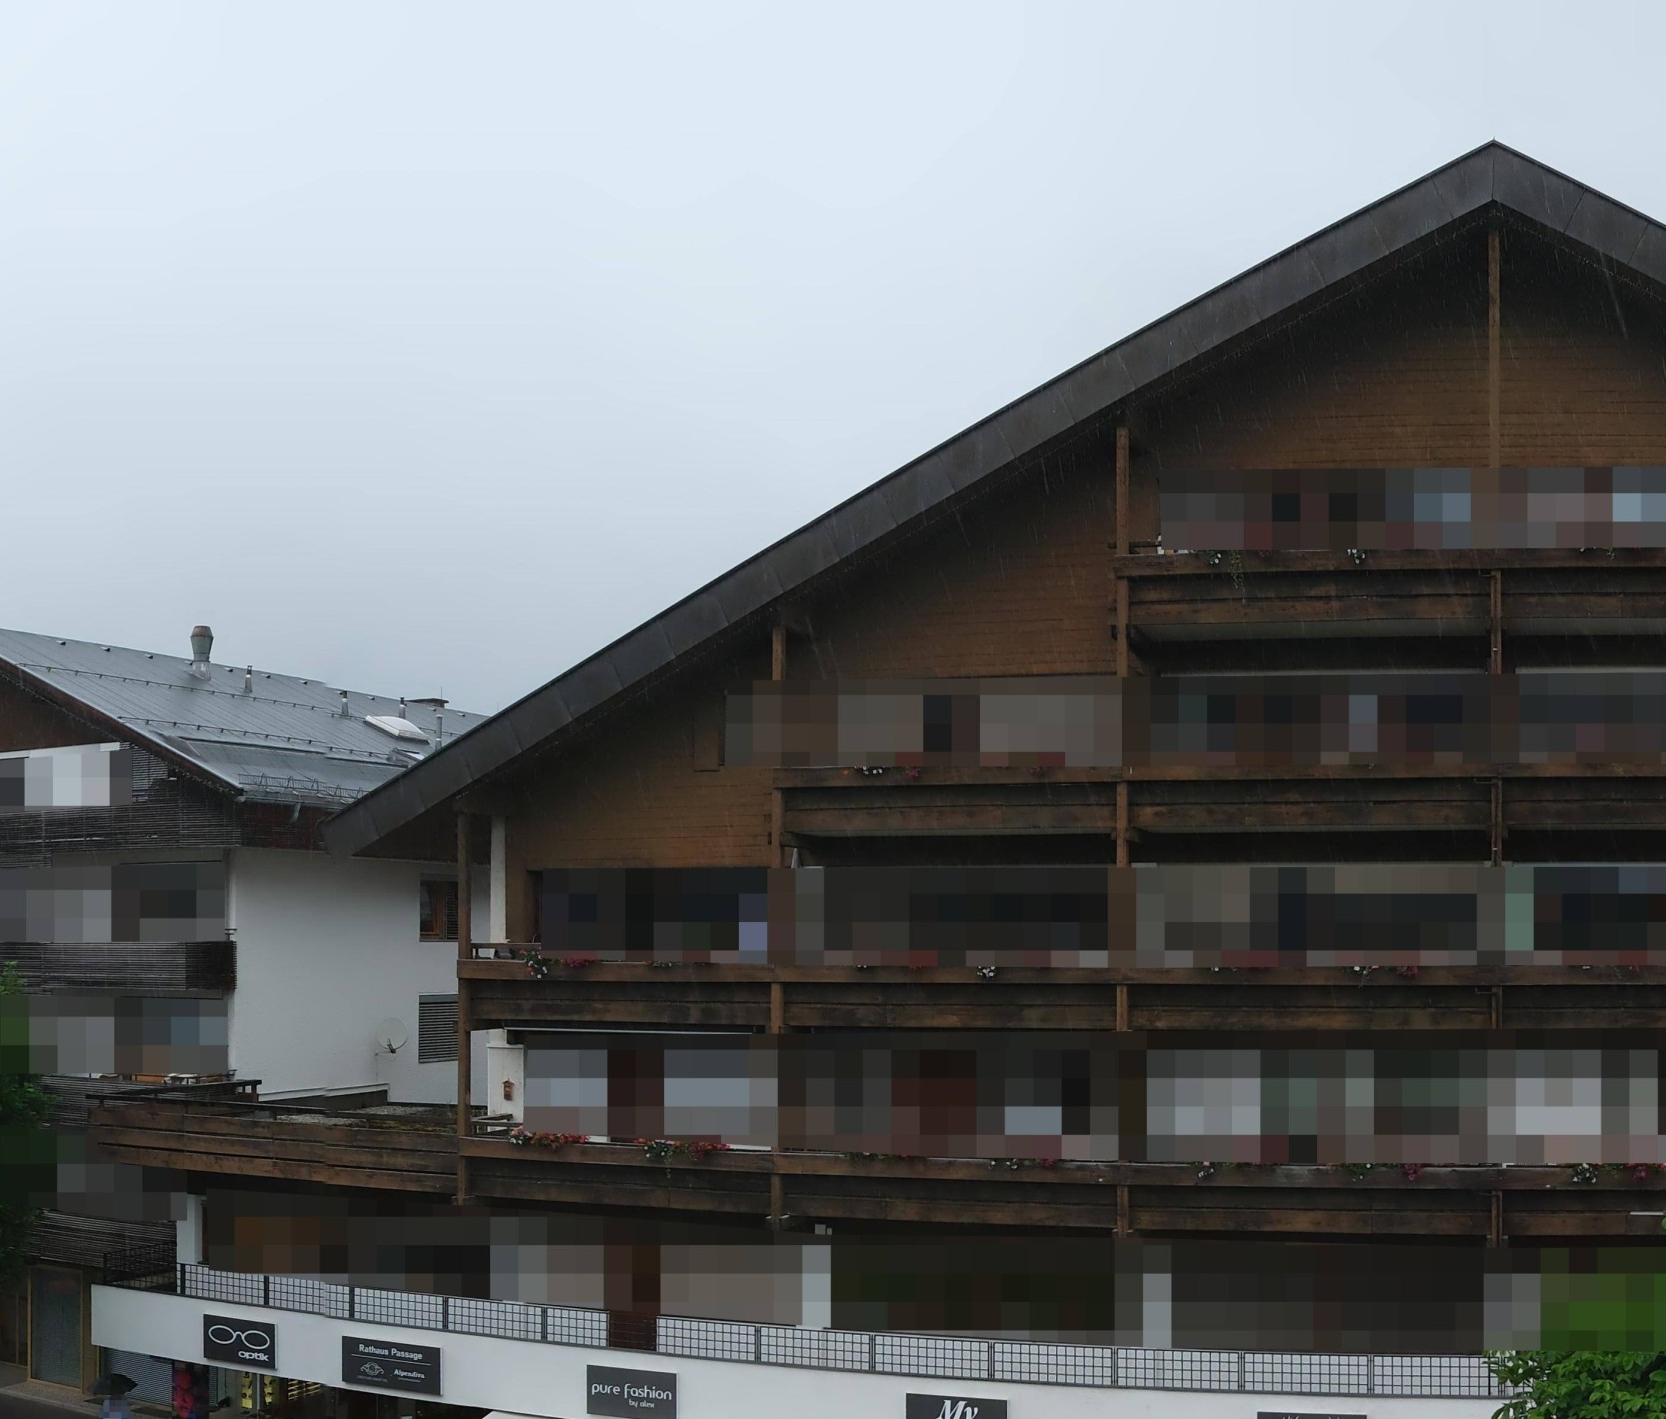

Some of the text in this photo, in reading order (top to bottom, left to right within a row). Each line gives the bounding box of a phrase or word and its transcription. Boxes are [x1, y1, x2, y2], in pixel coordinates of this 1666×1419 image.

[238, 1350, 270, 1362] optik
[359, 1344, 423, 1361] Rathaus Passage
[591, 1382, 673, 1401] pure fashion
[628, 1399, 655, 1409] by alex
